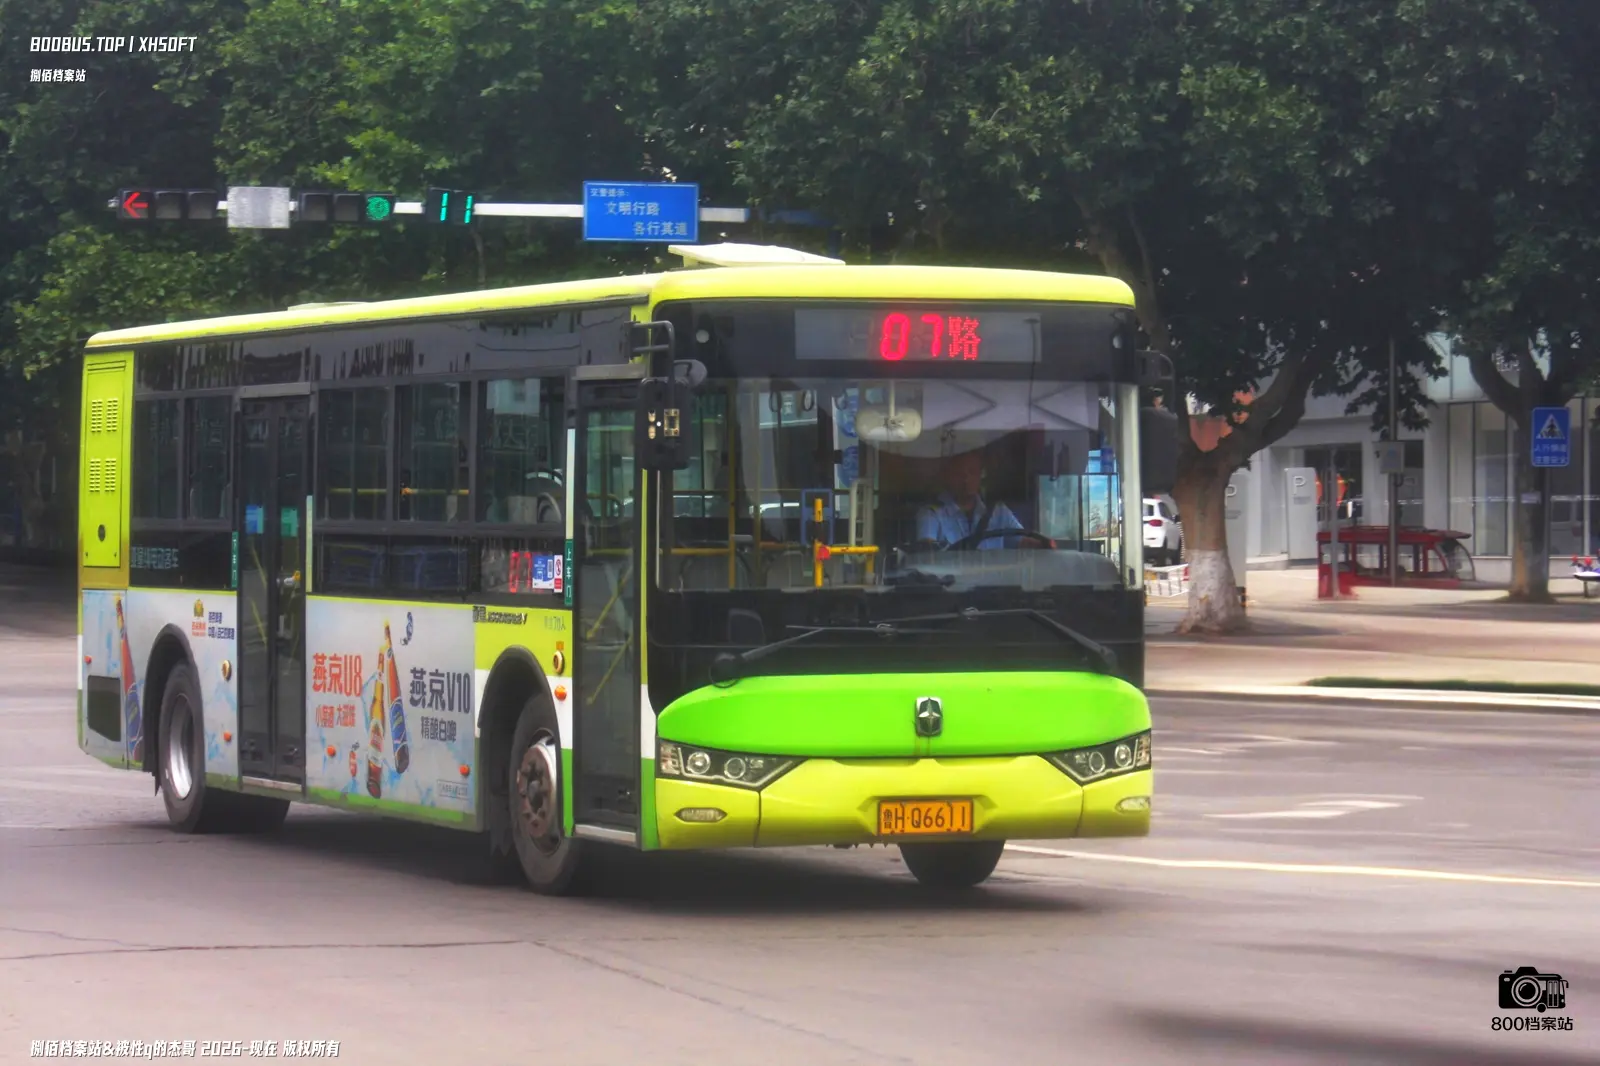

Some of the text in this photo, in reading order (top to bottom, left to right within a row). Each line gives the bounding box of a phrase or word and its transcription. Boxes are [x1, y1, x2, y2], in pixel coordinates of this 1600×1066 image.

[604, 201, 661, 216] 文明行路
[633, 221, 688, 236] 各行其道
[880, 312, 981, 361] 07路
[312, 653, 363, 697] 燕京U8
[409, 667, 471, 714] 燕京V10
[420, 716, 457, 742] 精酿白啤
